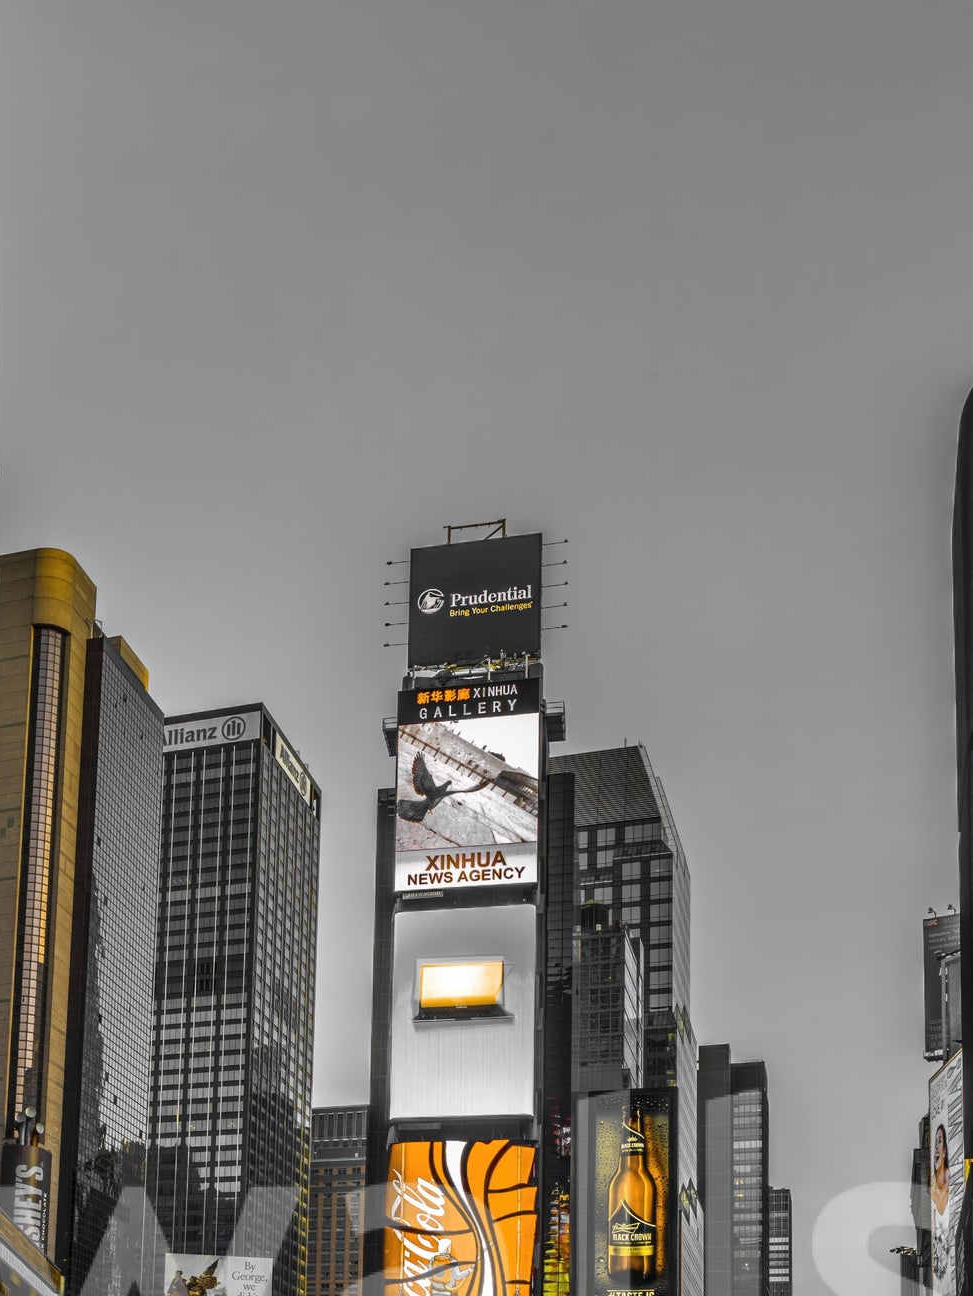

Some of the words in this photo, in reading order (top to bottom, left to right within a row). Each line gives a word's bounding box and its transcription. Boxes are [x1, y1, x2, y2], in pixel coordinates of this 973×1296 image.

[450, 585, 532, 608] Prudential
[449, 607, 470, 617] Bring
[471, 606, 488, 614] Your
[490, 602, 532, 613] Challenges
[416, 688, 471, 705] 新华影廊
[473, 684, 518, 699] XINHUA
[419, 699, 518, 720] GALLERY
[425, 851, 507, 871] XINHUA
[407, 870, 454, 886] NEWS
[457, 866, 526, 882] AGENCY
[612, 1233, 630, 1242] BLACK
[630, 1232, 652, 1242] CROWN
[244, 1261, 257, 1273] By
[232, 1271, 268, 1284] George,
